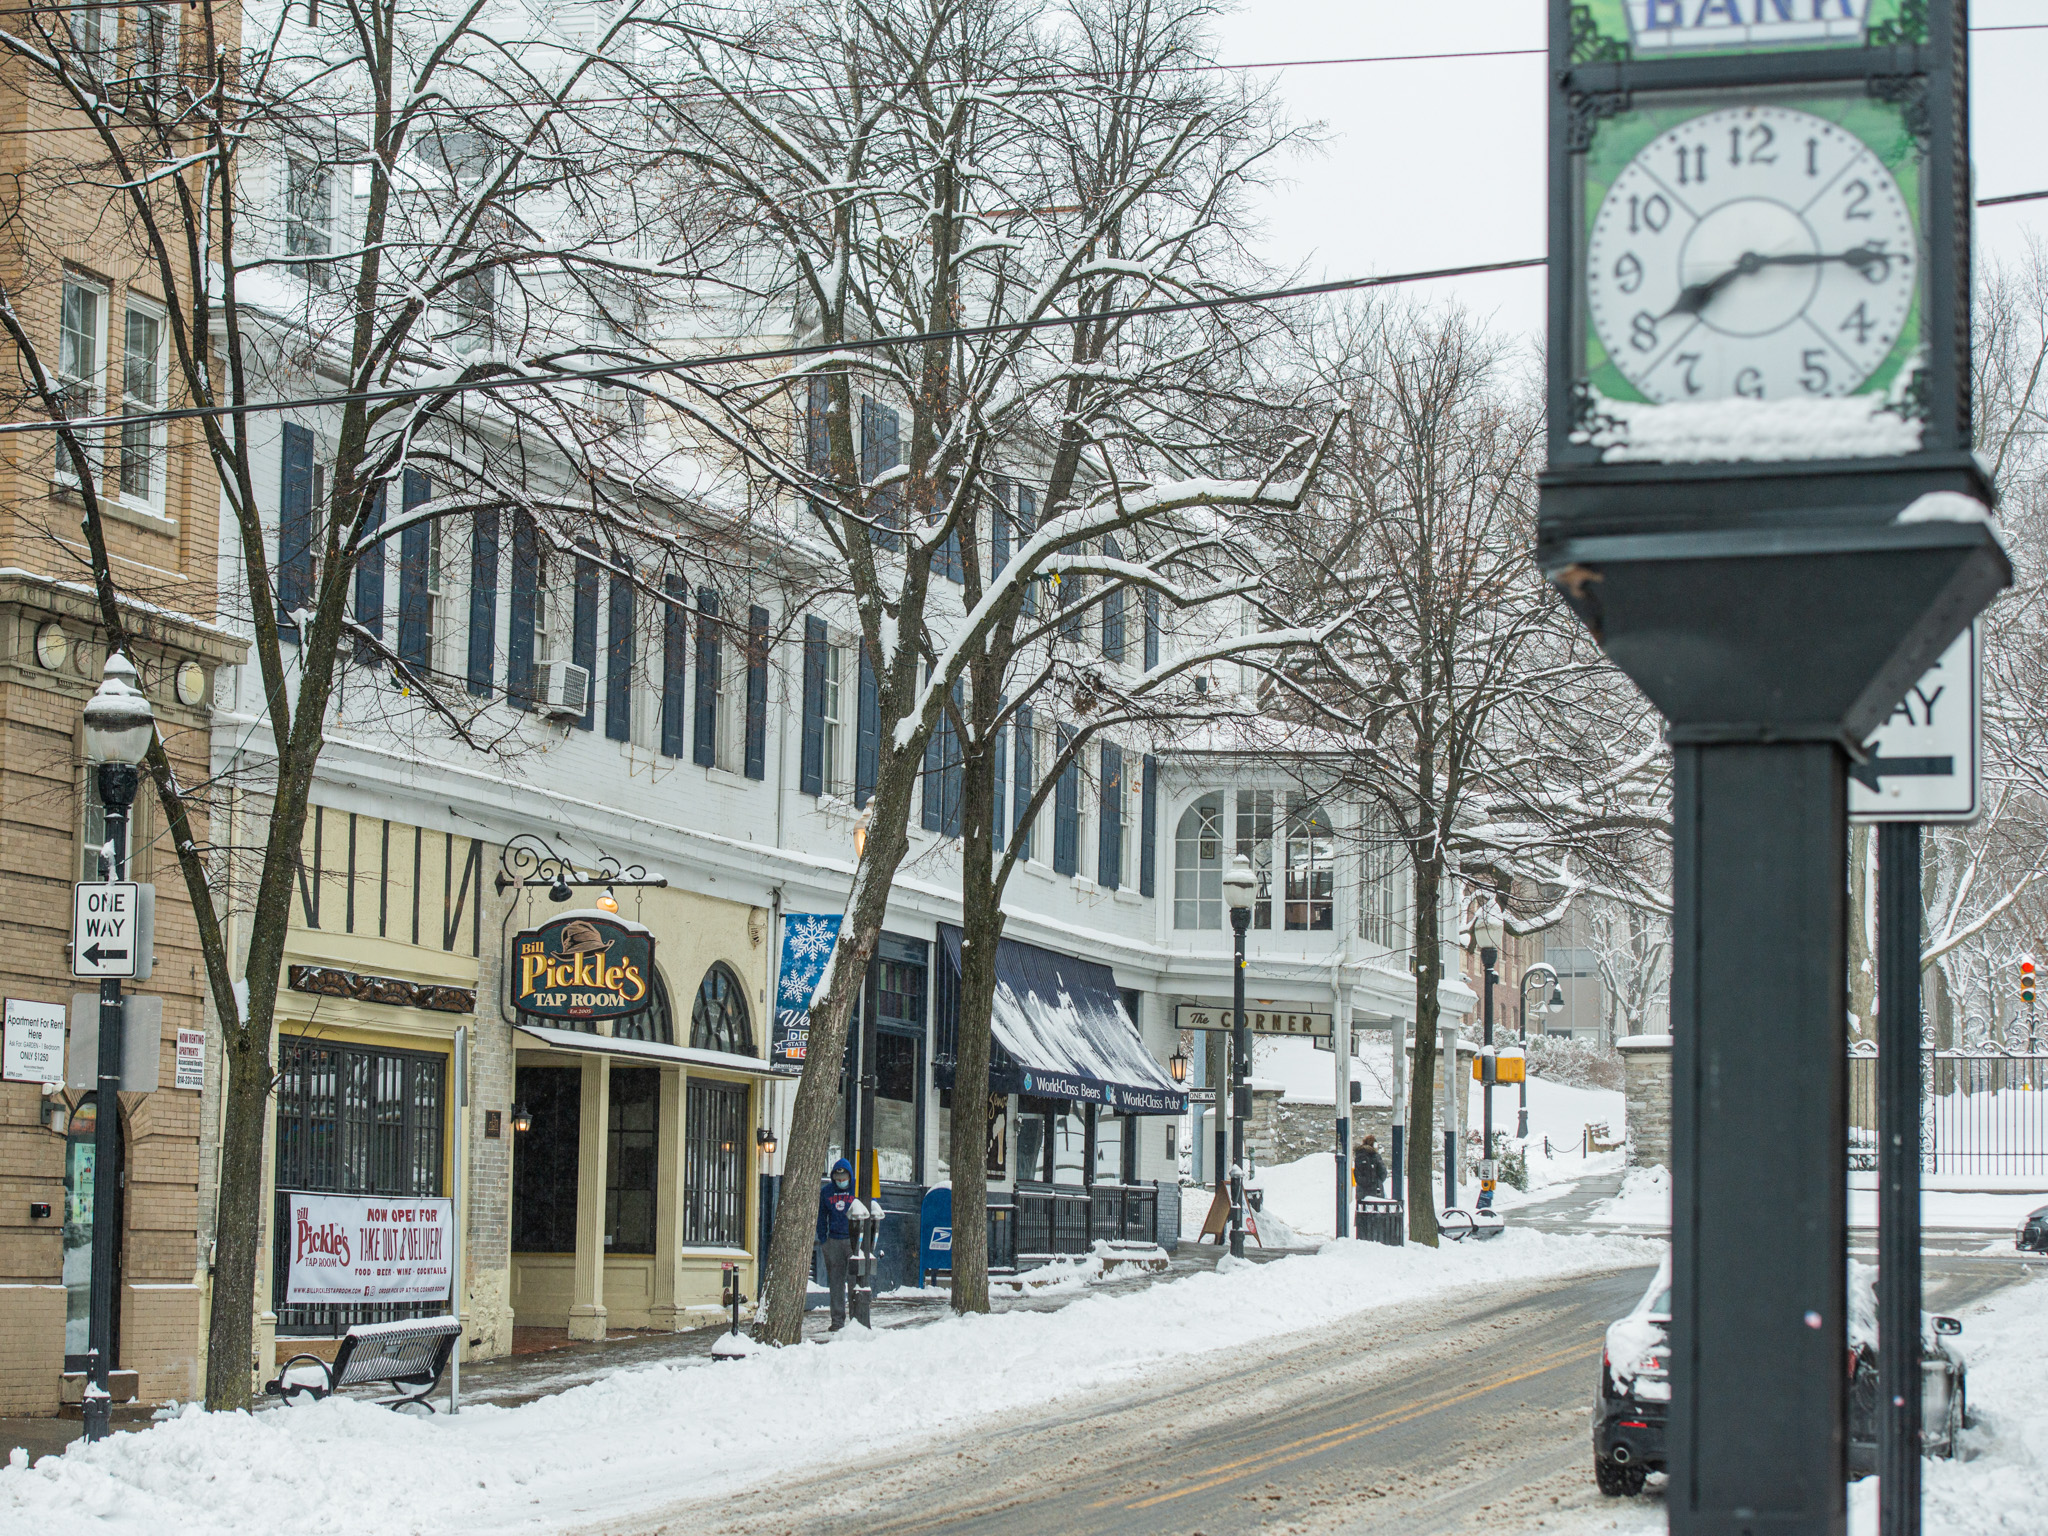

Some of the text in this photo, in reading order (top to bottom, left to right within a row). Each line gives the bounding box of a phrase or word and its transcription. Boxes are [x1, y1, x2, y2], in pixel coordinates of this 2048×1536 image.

[1727, 124, 1779, 166] 12
[1675, 143, 1708, 186] 11
[1806, 137, 1819, 177] 1
[1843, 179, 1873, 220] 2
[1627, 193, 1671, 234] 10
[1614, 252, 1643, 294] 9
[1629, 311, 1659, 353] 8
[1839, 302, 1876, 345] 4
[1673, 353, 1704, 396] 7
[1800, 349, 1831, 393] 5
[1882, 685, 1944, 726] AY
[88, 893, 125, 912] ONE
[86, 918, 125, 937] WAY
[521, 941, 544, 955] Bill
[520, 952, 646, 1001] Pickle's
[533, 993, 625, 1007] TAP ROOM
[8, 1015, 63, 1029] Apartment For Rent
[1190, 1012, 1209, 1025] The
[28, 1029, 42, 1039] Here
[179, 1033, 204, 1045] NOW RENTING
[20, 1051, 33, 1061] ONLY
[1036, 1076, 1101, 1099] World-Class Beers
[1122, 1091, 1163, 1109] World-Class
[296, 1207, 309, 1220] Bill
[367, 1208, 388, 1222] NOW
[419, 1209, 438, 1222] FOR
[296, 1219, 351, 1267] Pickle's
[359, 1227, 381, 1261] TAKE
[383, 1228, 399, 1261] OUT
[407, 1227, 443, 1261] DELIVERY
[305, 1257, 337, 1267] TAP ROOM
[355, 1267, 447, 1276] FOOD BEER WINE COCKTAILS
